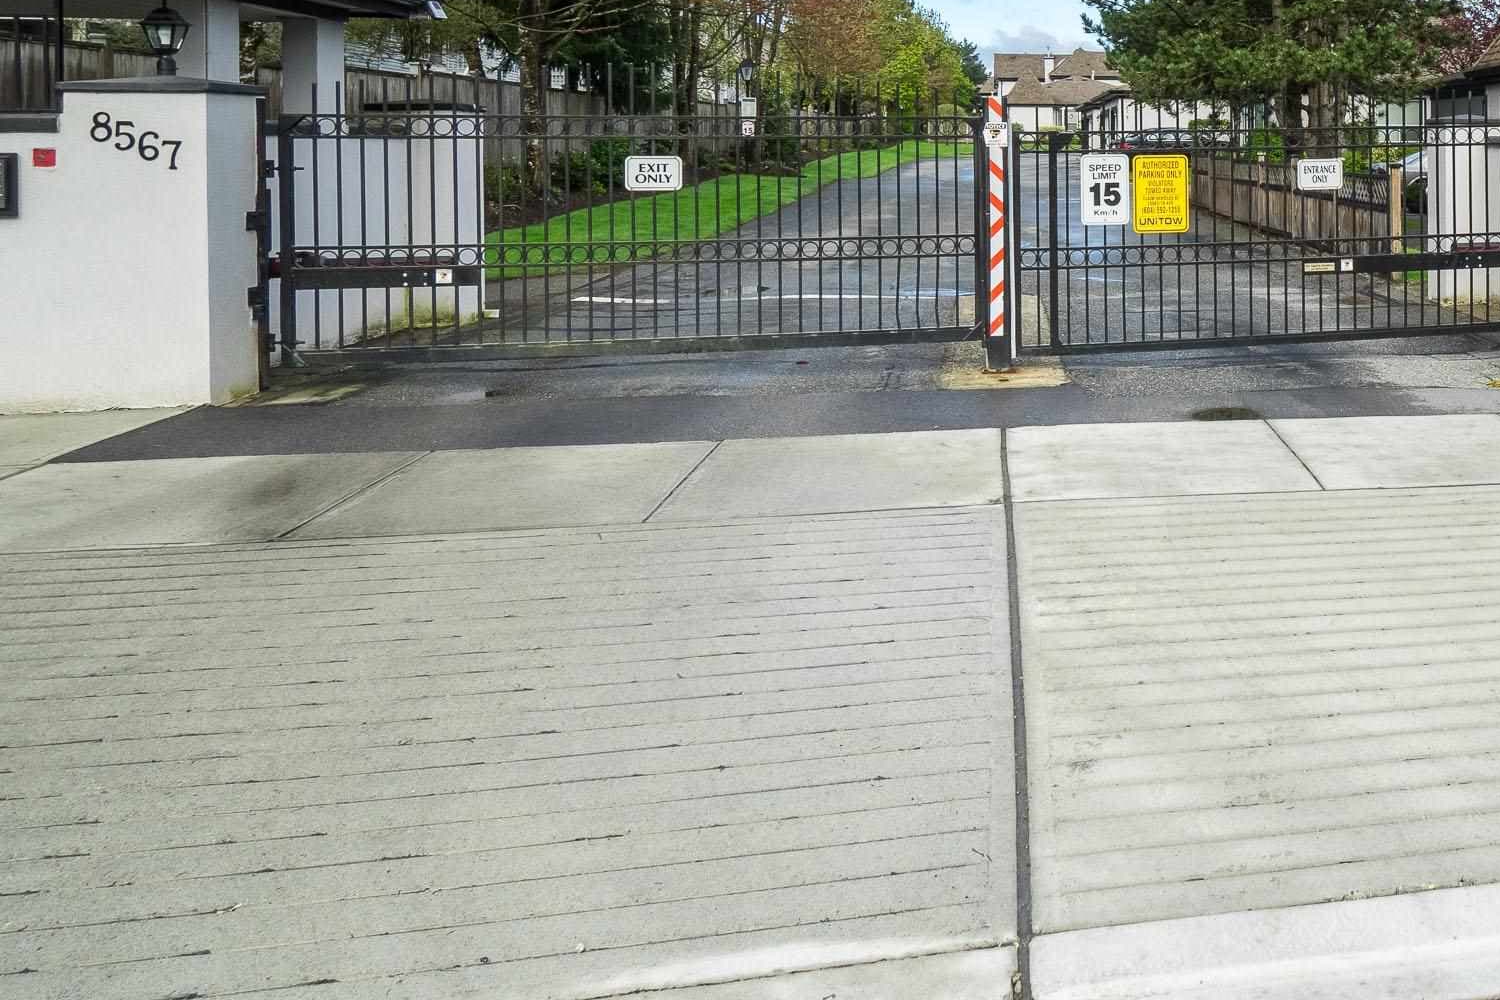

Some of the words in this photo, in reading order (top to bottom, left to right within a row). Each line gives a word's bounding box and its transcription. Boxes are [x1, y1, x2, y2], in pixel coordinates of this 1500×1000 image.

[90, 111, 182, 170] 8567
[639, 163, 672, 173] EXIT
[1088, 164, 1121, 172] SPEED
[1142, 161, 1179, 169] AUTHORIZED
[1304, 165, 1336, 174] ENTRANCE
[635, 173, 672, 184] ONLY
[1092, 172, 1117, 180] LIMIT
[1138, 170, 1165, 179] PARKING
[1166, 170, 1183, 179] ONLY
[1312, 174, 1328, 183] ONLY
[1089, 182, 1121, 207] 15
